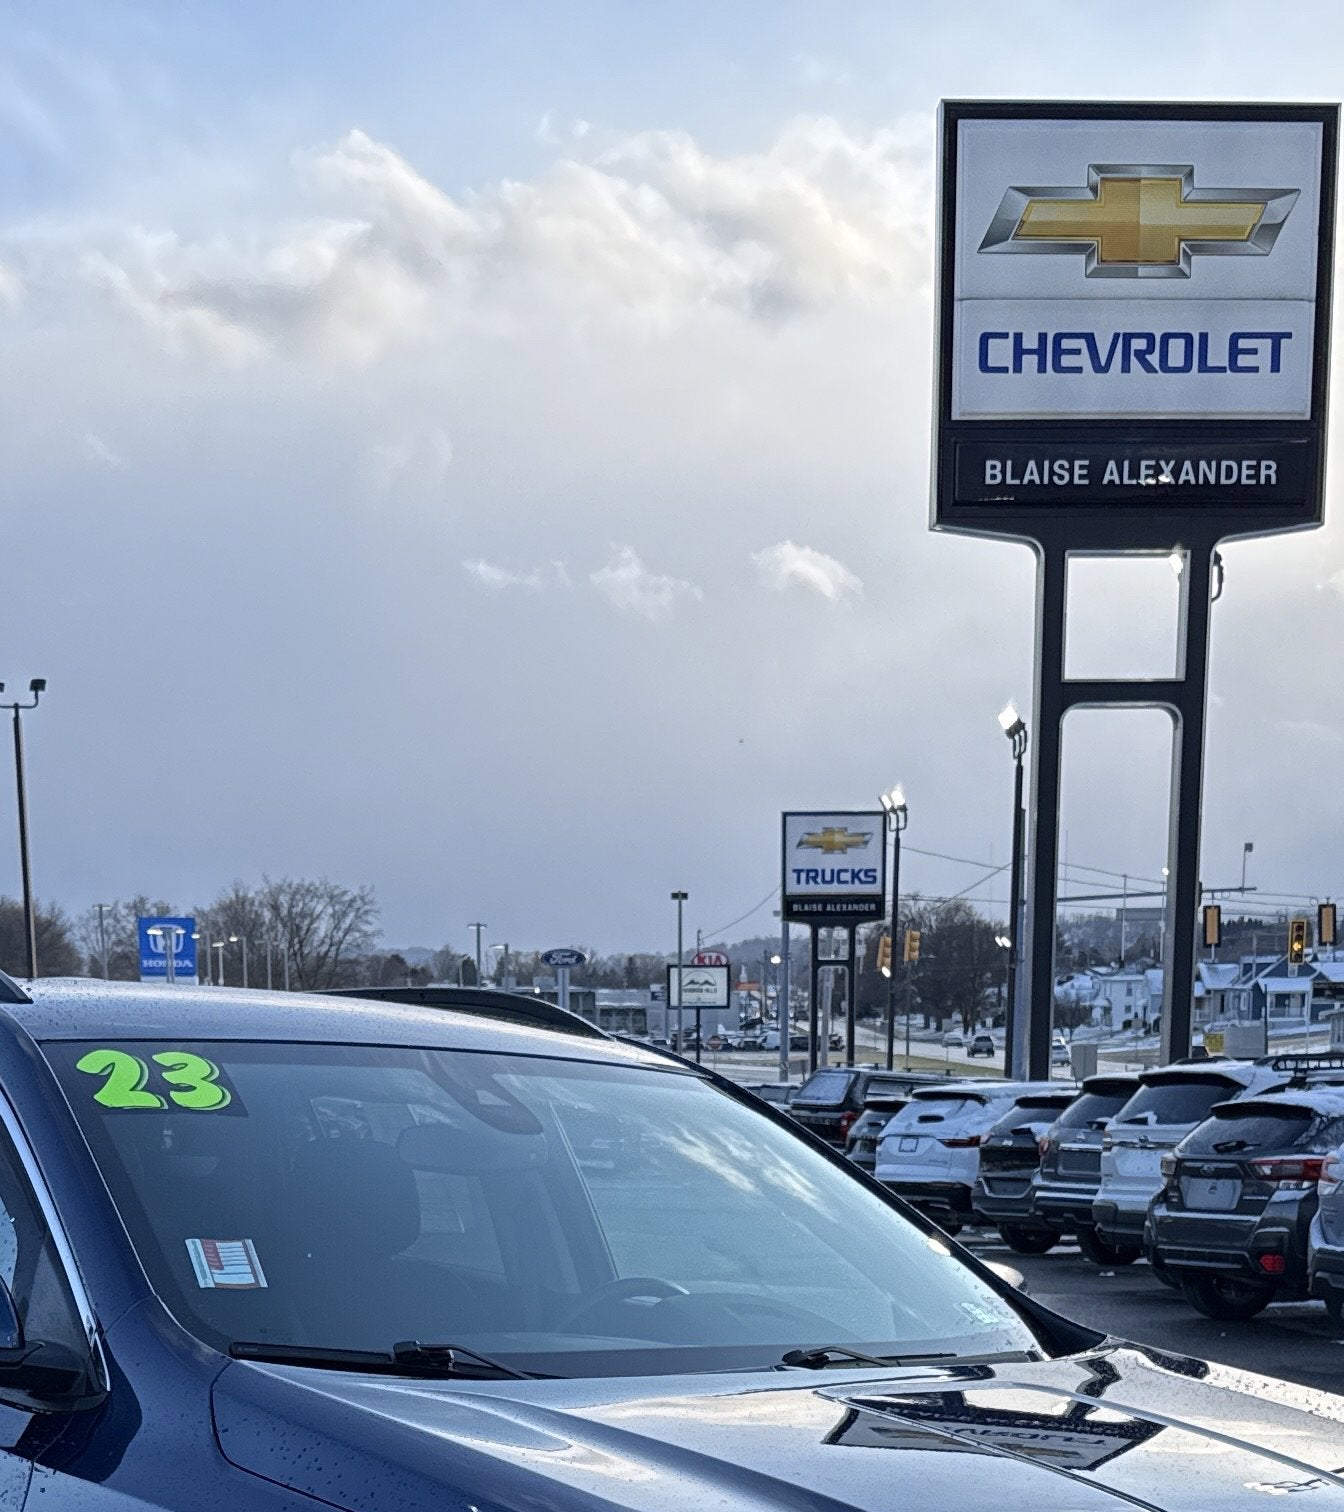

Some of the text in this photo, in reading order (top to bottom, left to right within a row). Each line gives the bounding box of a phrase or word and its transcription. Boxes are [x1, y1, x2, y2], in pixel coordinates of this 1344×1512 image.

[978, 331, 1293, 375] CHEVROLET
[984, 459, 1277, 486] BLAISE ALEXANDER
[792, 868, 878, 886] TRUCKS
[792, 904, 876, 912] BLAISE ALEXANDER
[76, 1048, 232, 1111] 23
